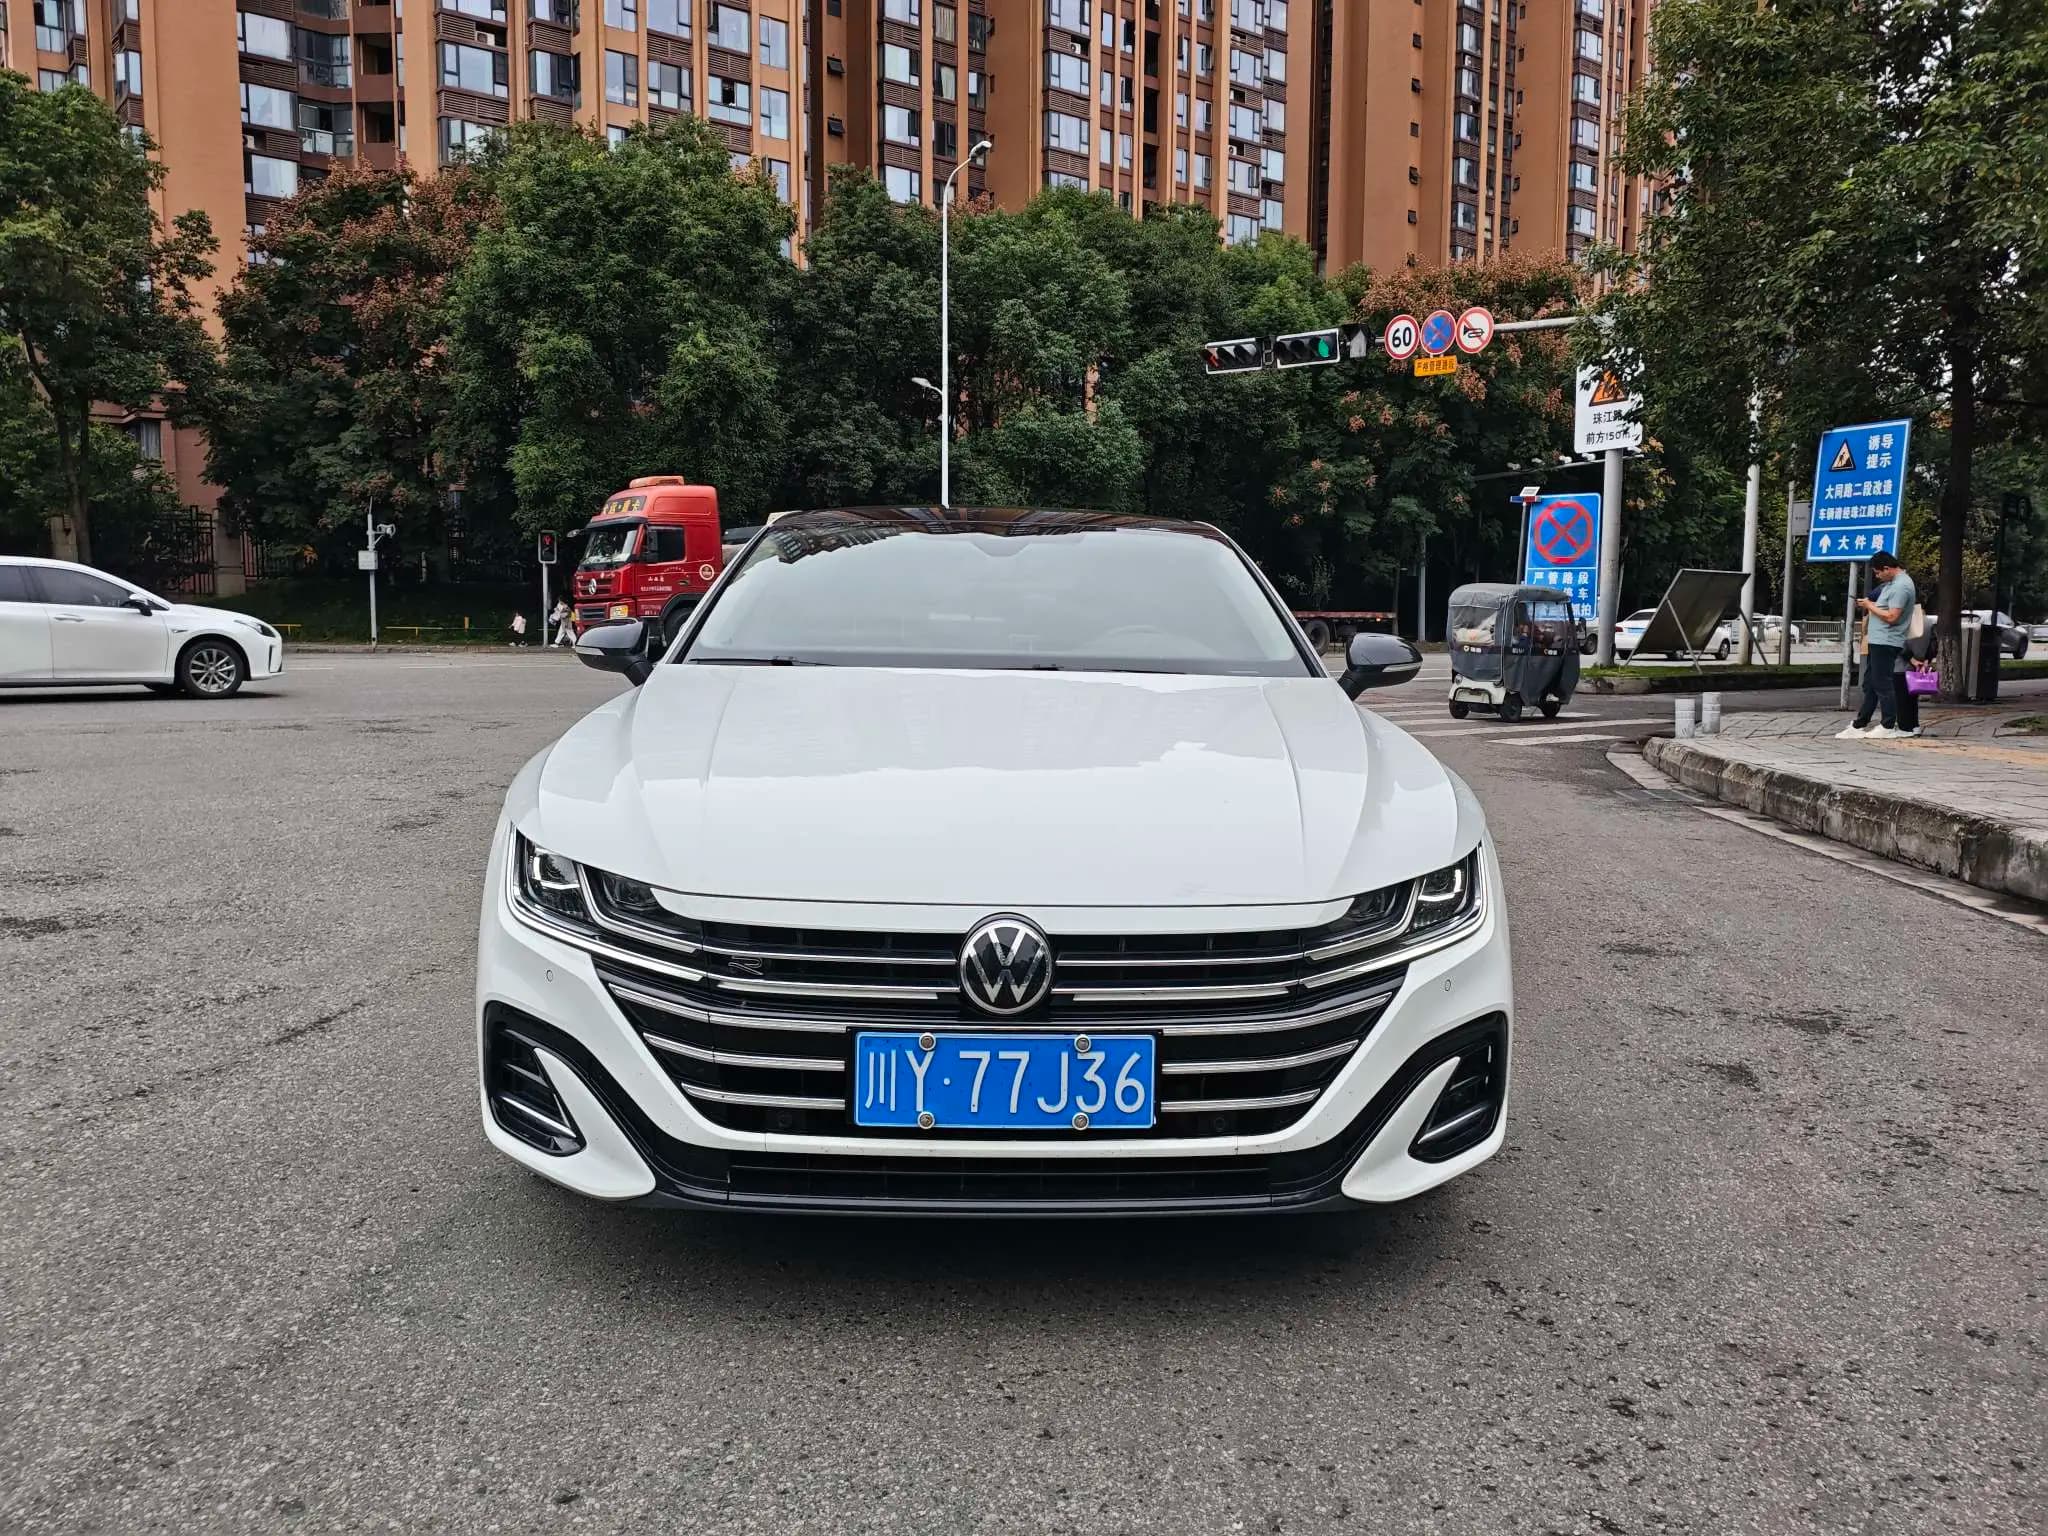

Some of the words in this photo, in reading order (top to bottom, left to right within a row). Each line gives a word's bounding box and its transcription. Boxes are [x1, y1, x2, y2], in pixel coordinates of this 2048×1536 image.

[1392, 326, 1412, 348] 60
[1593, 409, 1623, 425] 珠江路
[1868, 433, 1894, 451] 诱导
[1866, 452, 1892, 470] 提示
[1824, 479, 1893, 500] 大同路二段改造
[1837, 533, 1885, 552] 大件路
[1532, 571, 1589, 585] 严管路段
